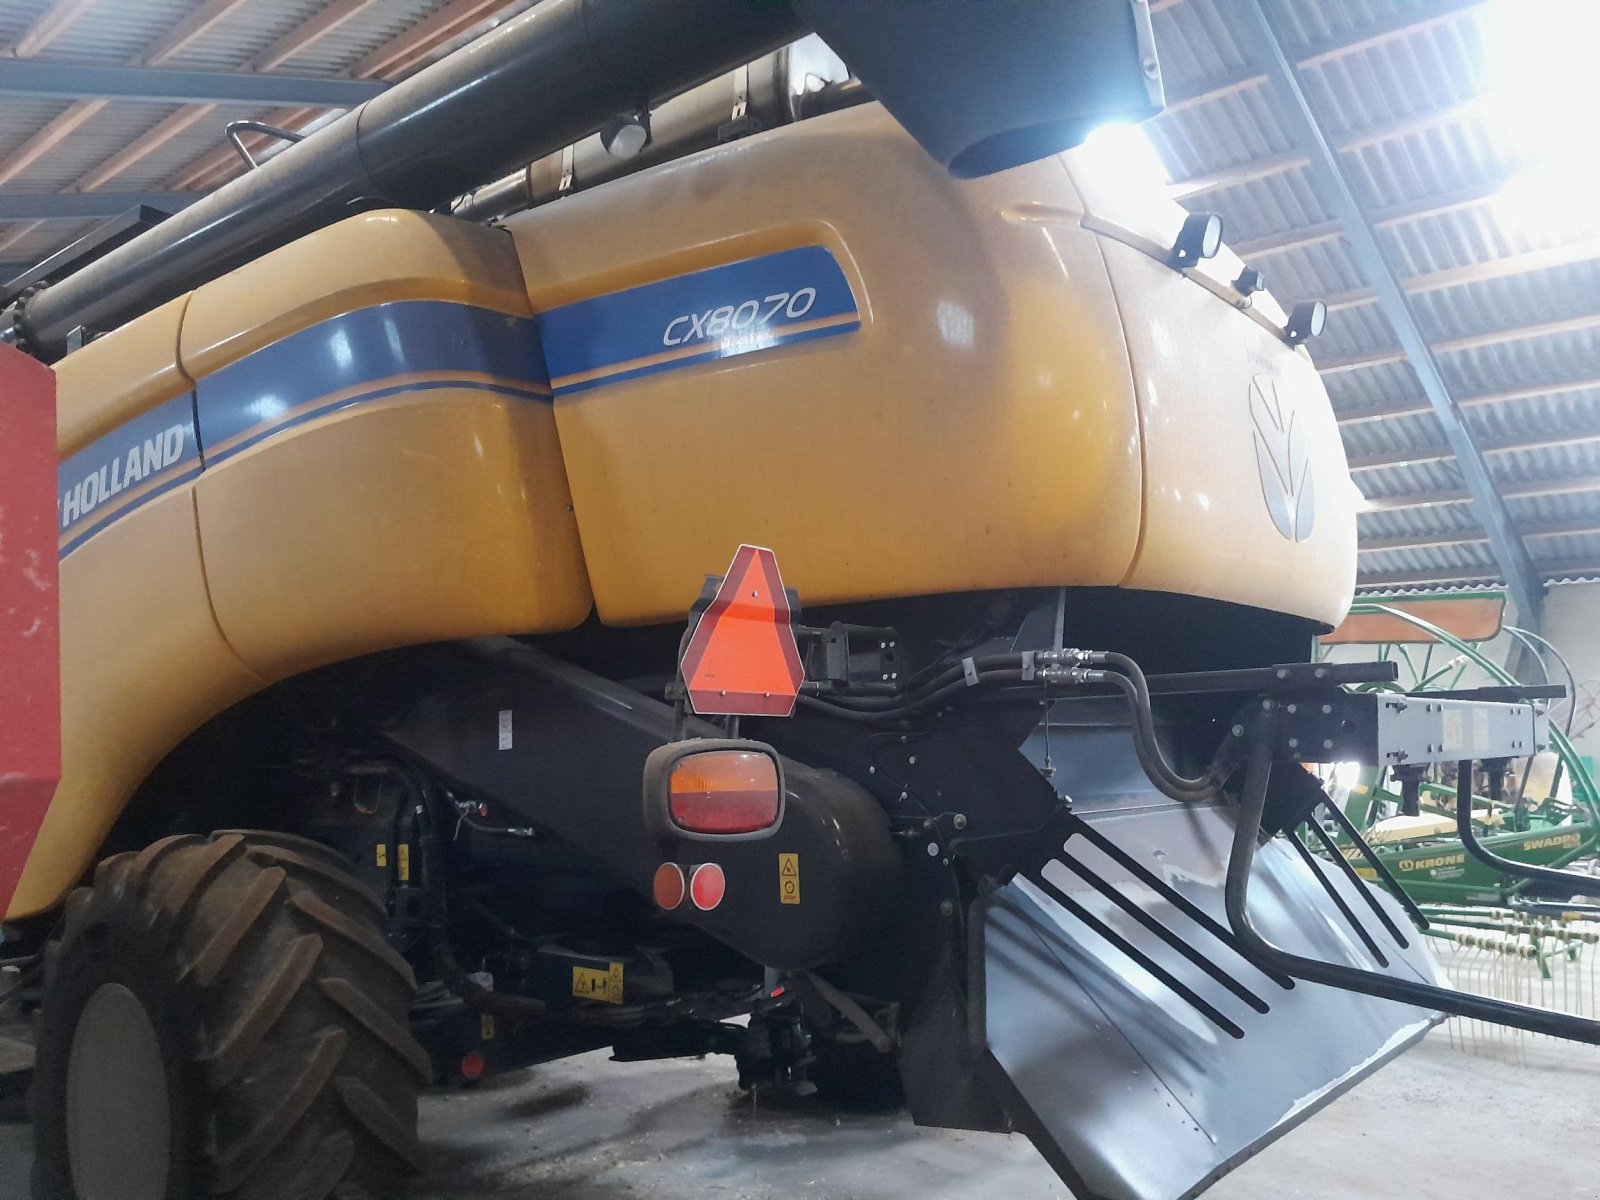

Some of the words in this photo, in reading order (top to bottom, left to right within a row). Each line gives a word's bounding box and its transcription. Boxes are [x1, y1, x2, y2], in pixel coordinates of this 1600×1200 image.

[663, 287, 816, 346] CX8070
[62, 424, 184, 527] HOLLAND
[1415, 854, 1465, 869] KRONE
